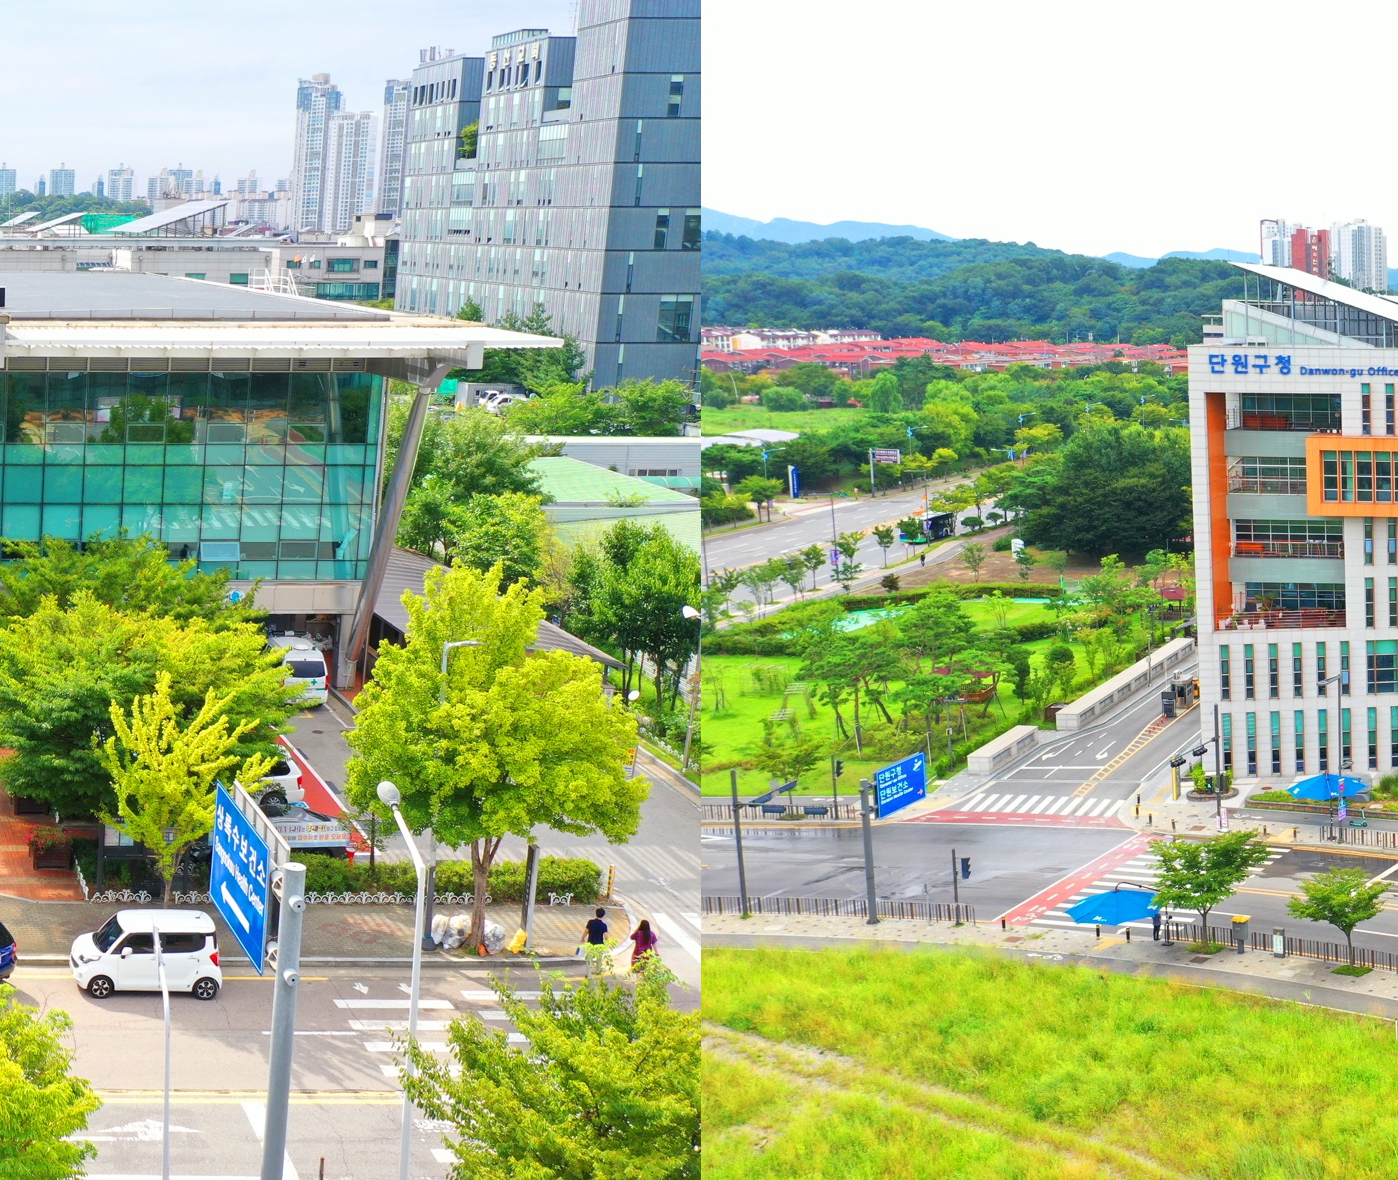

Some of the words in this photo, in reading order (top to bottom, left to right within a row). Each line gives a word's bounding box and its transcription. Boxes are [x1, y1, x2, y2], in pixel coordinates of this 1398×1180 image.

[489, 40, 540, 70] 동산교회
[1208, 354, 1292, 375] 단원구청
[1300, 366, 1364, 378] Danwon-gu
[879, 765, 902, 784] 단원구청
[880, 781, 909, 800] 단원보건소
[217, 804, 266, 888] 상록수보건소
[234, 864, 249, 896] Health
[248, 883, 264, 917] Center
